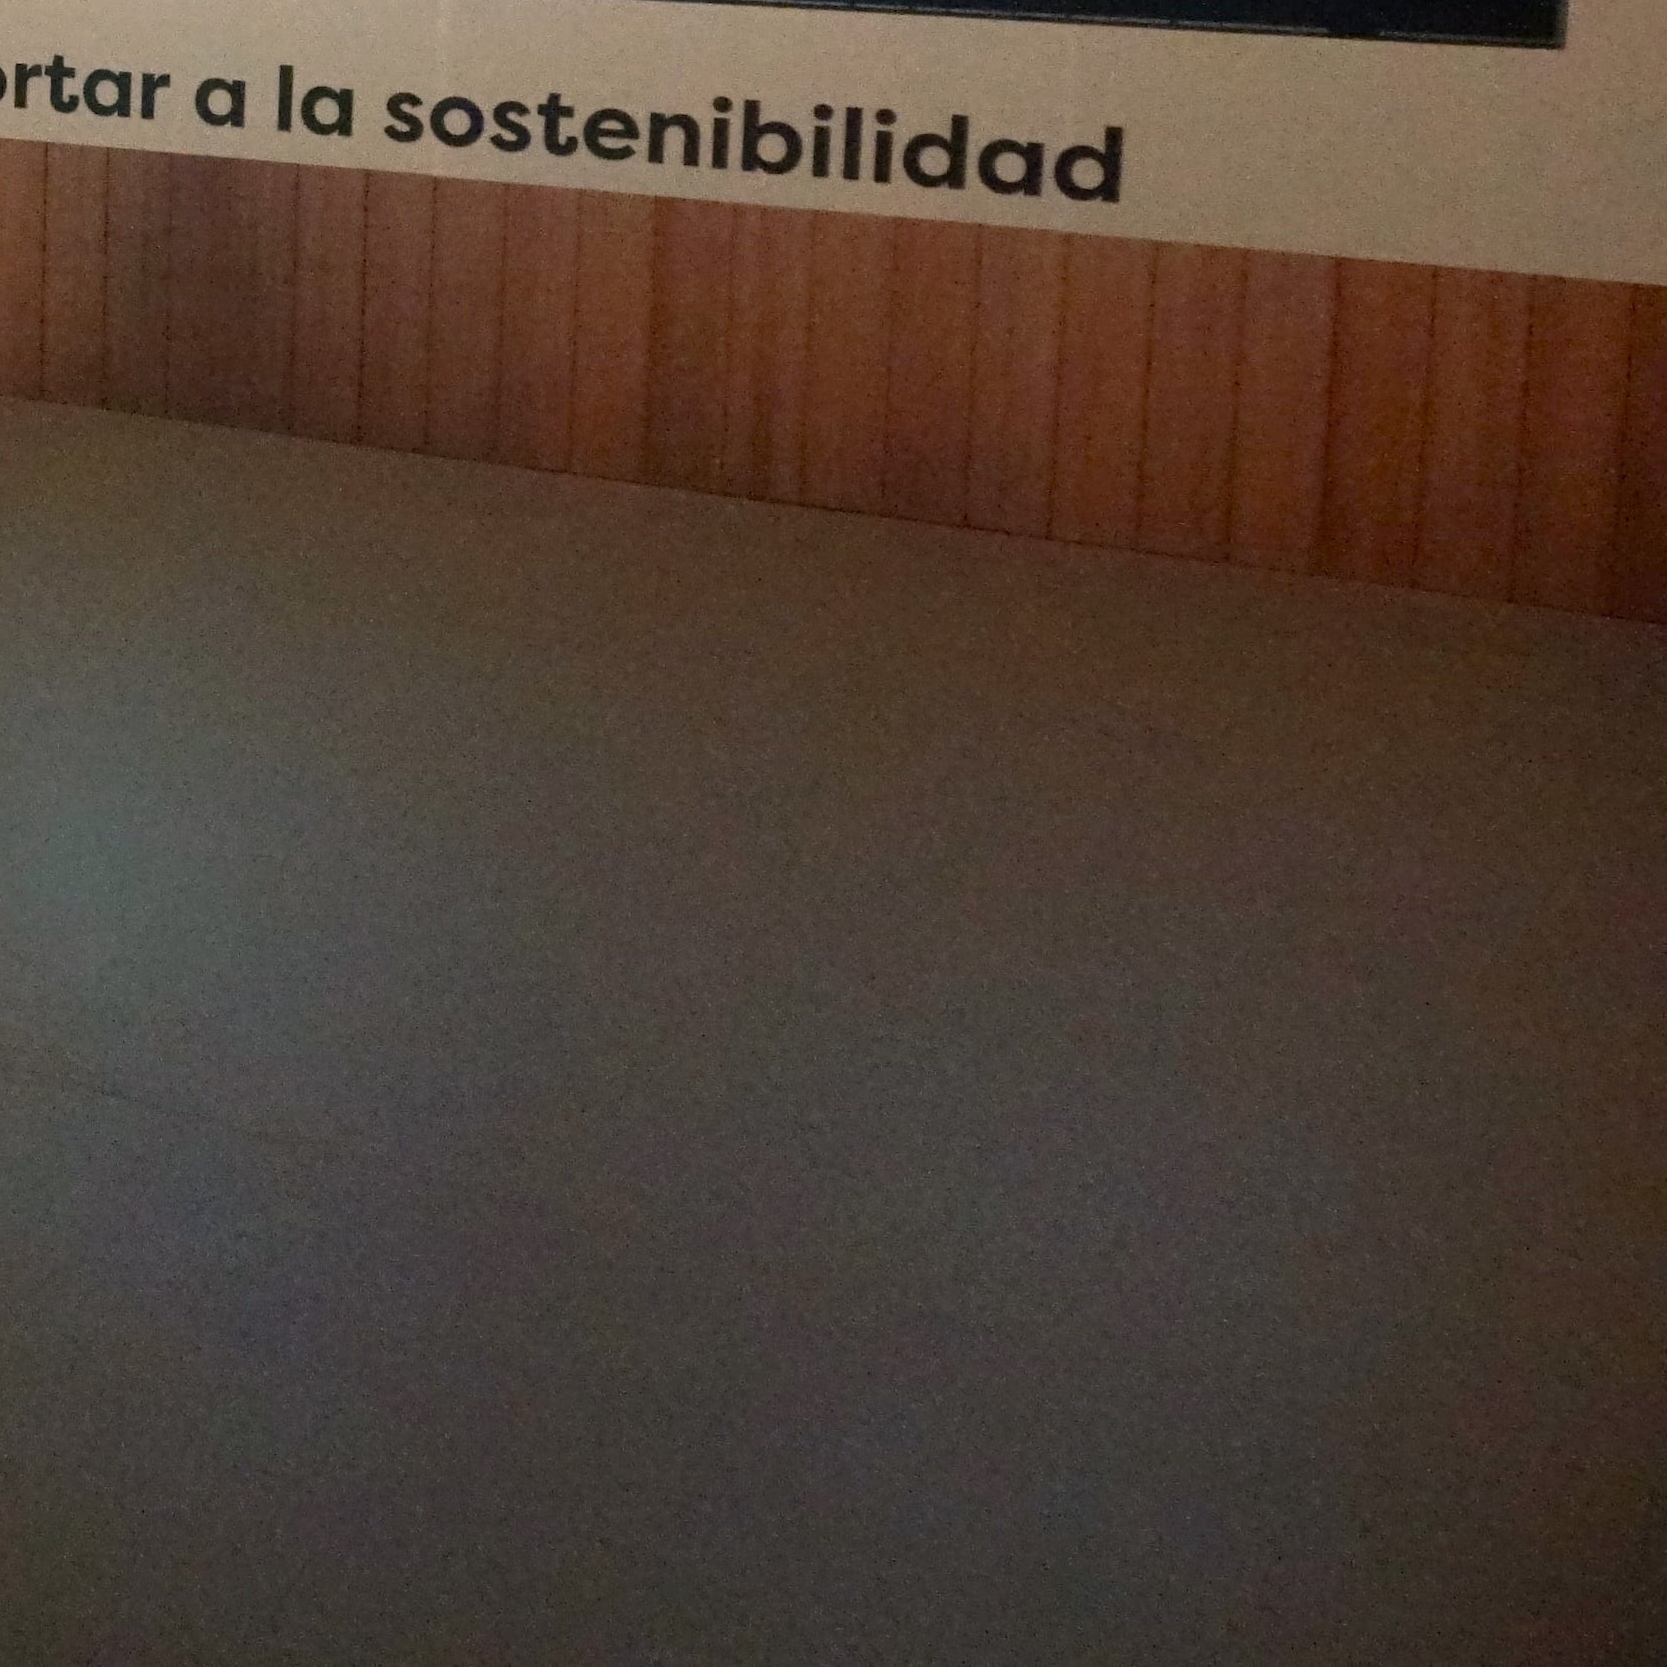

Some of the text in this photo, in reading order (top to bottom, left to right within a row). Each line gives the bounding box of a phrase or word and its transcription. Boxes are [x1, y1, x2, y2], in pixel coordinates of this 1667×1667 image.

[193, 74, 248, 129] a
[277, 64, 356, 137] la
[383, 89, 1125, 203] sostenibilidad
